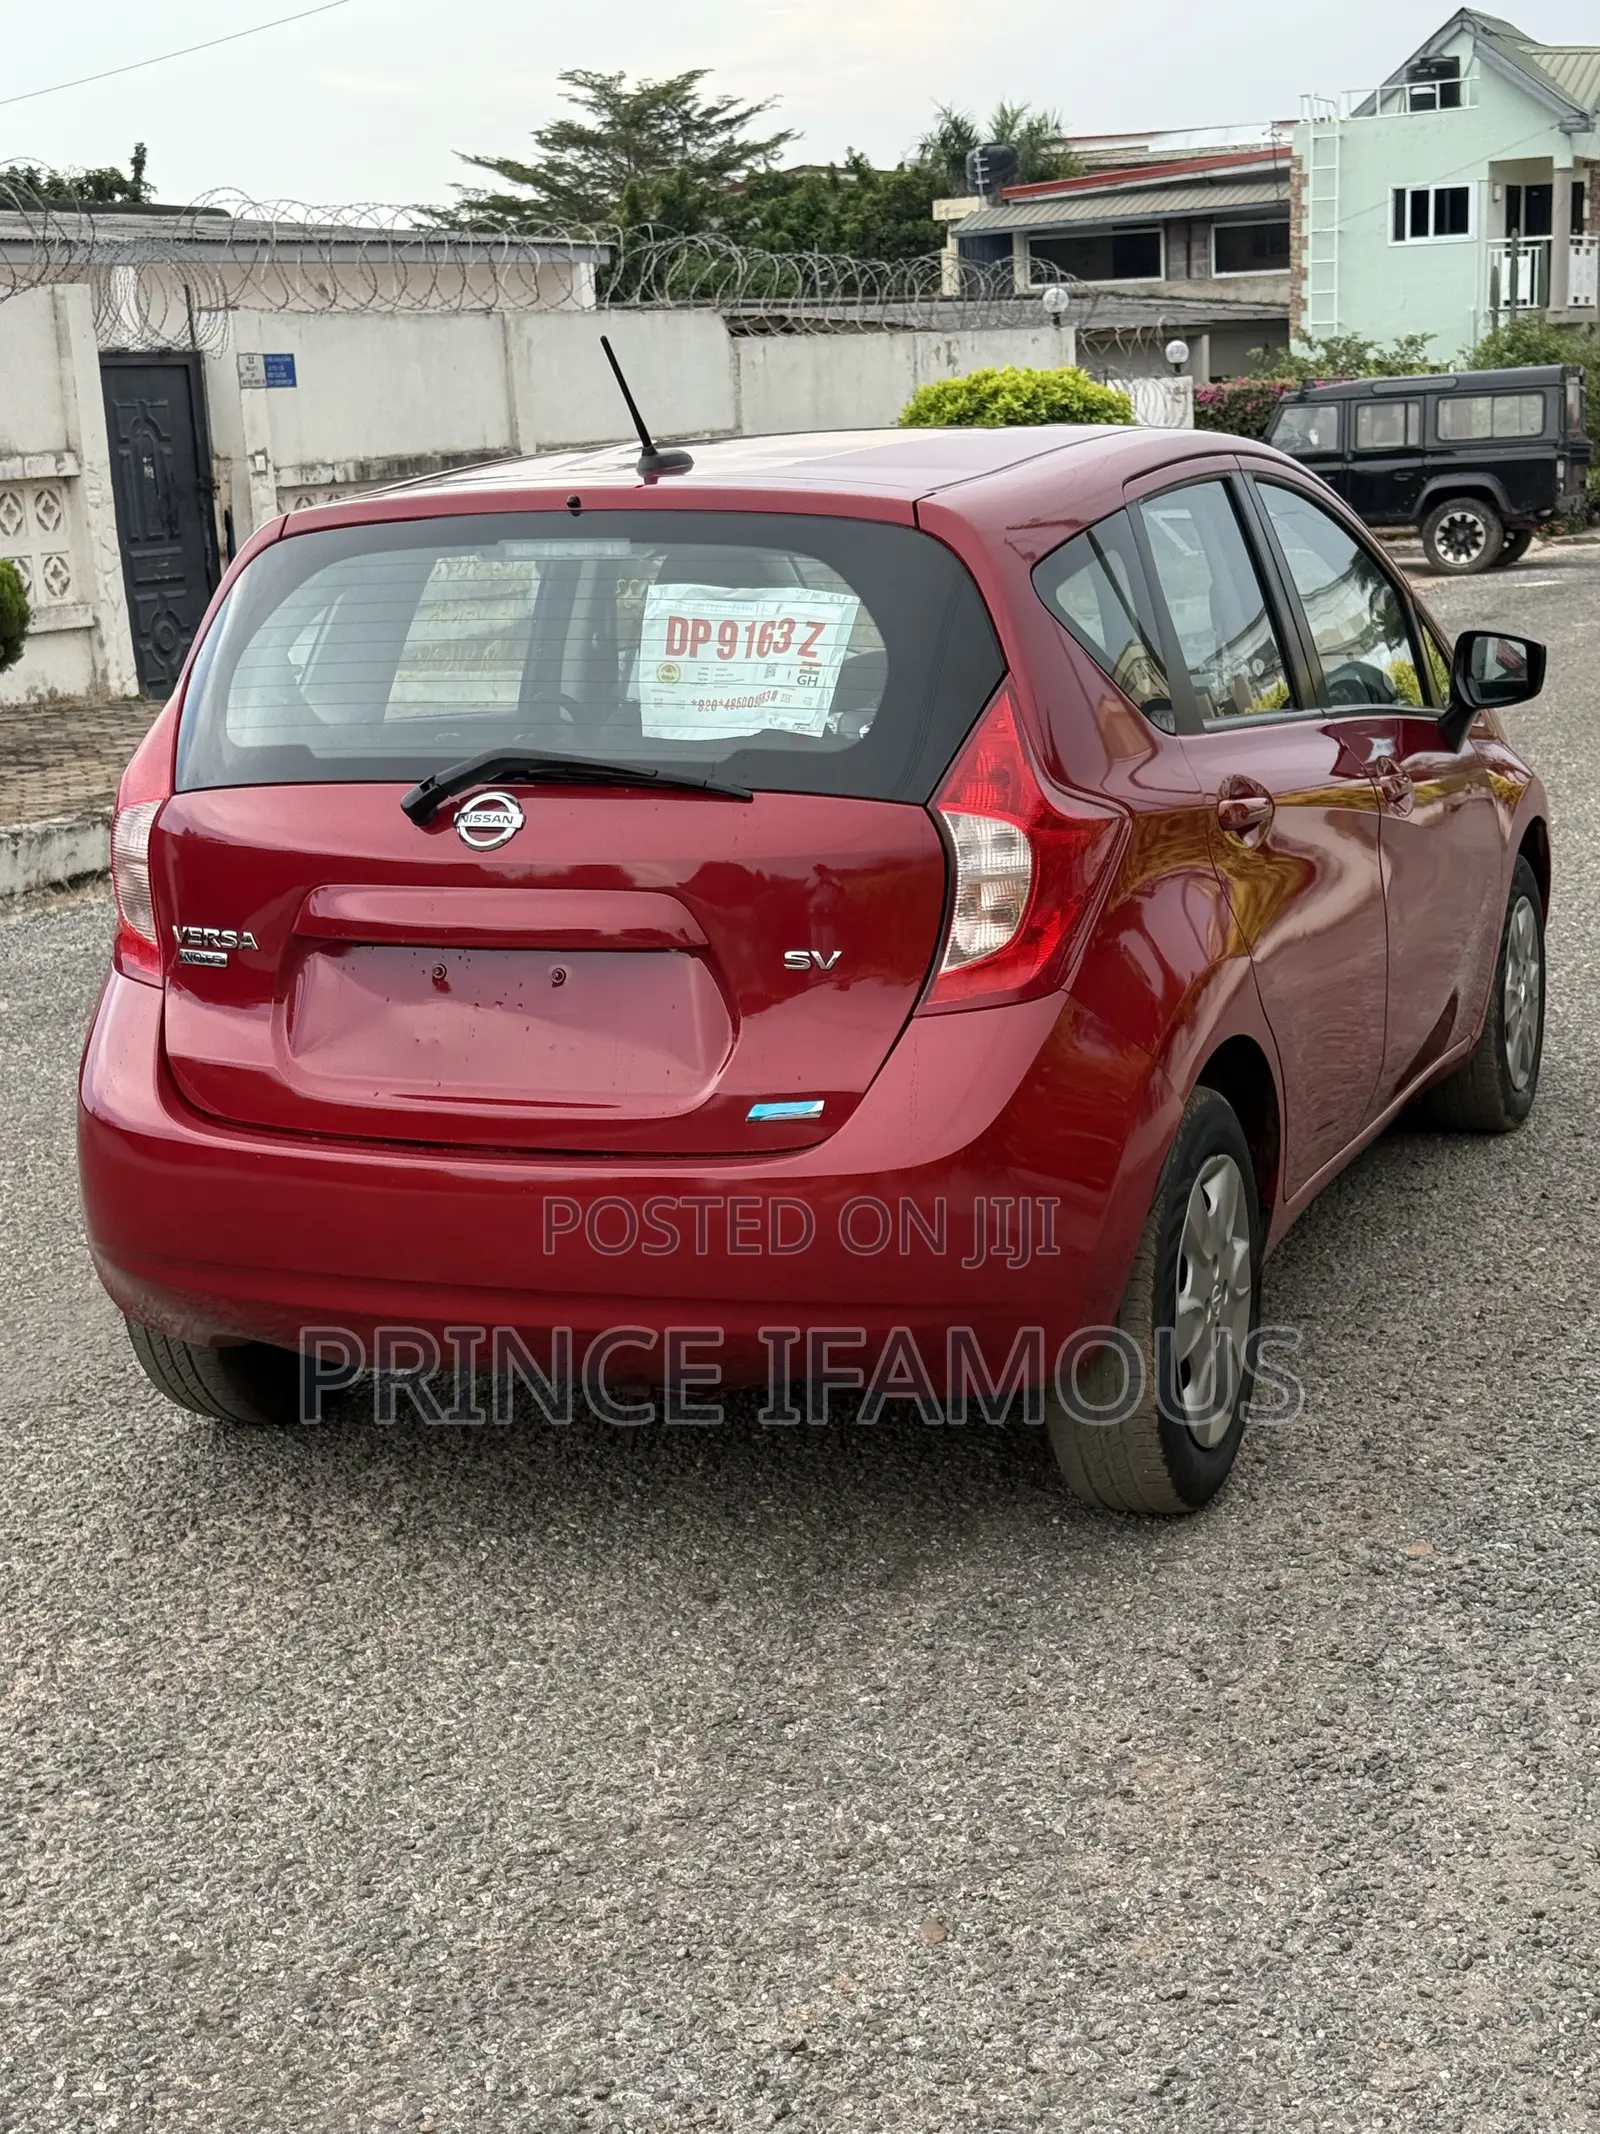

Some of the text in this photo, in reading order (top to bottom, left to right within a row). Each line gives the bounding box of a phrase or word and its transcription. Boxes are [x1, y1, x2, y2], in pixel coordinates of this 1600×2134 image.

[665, 616, 826, 661] DP 9163 Z
[797, 675, 819, 687] GH
[459, 814, 514, 825] NISSAN
[172, 925, 259, 950] VERSA
[182, 951, 224, 965] NOTE
[783, 950, 843, 970] SV
